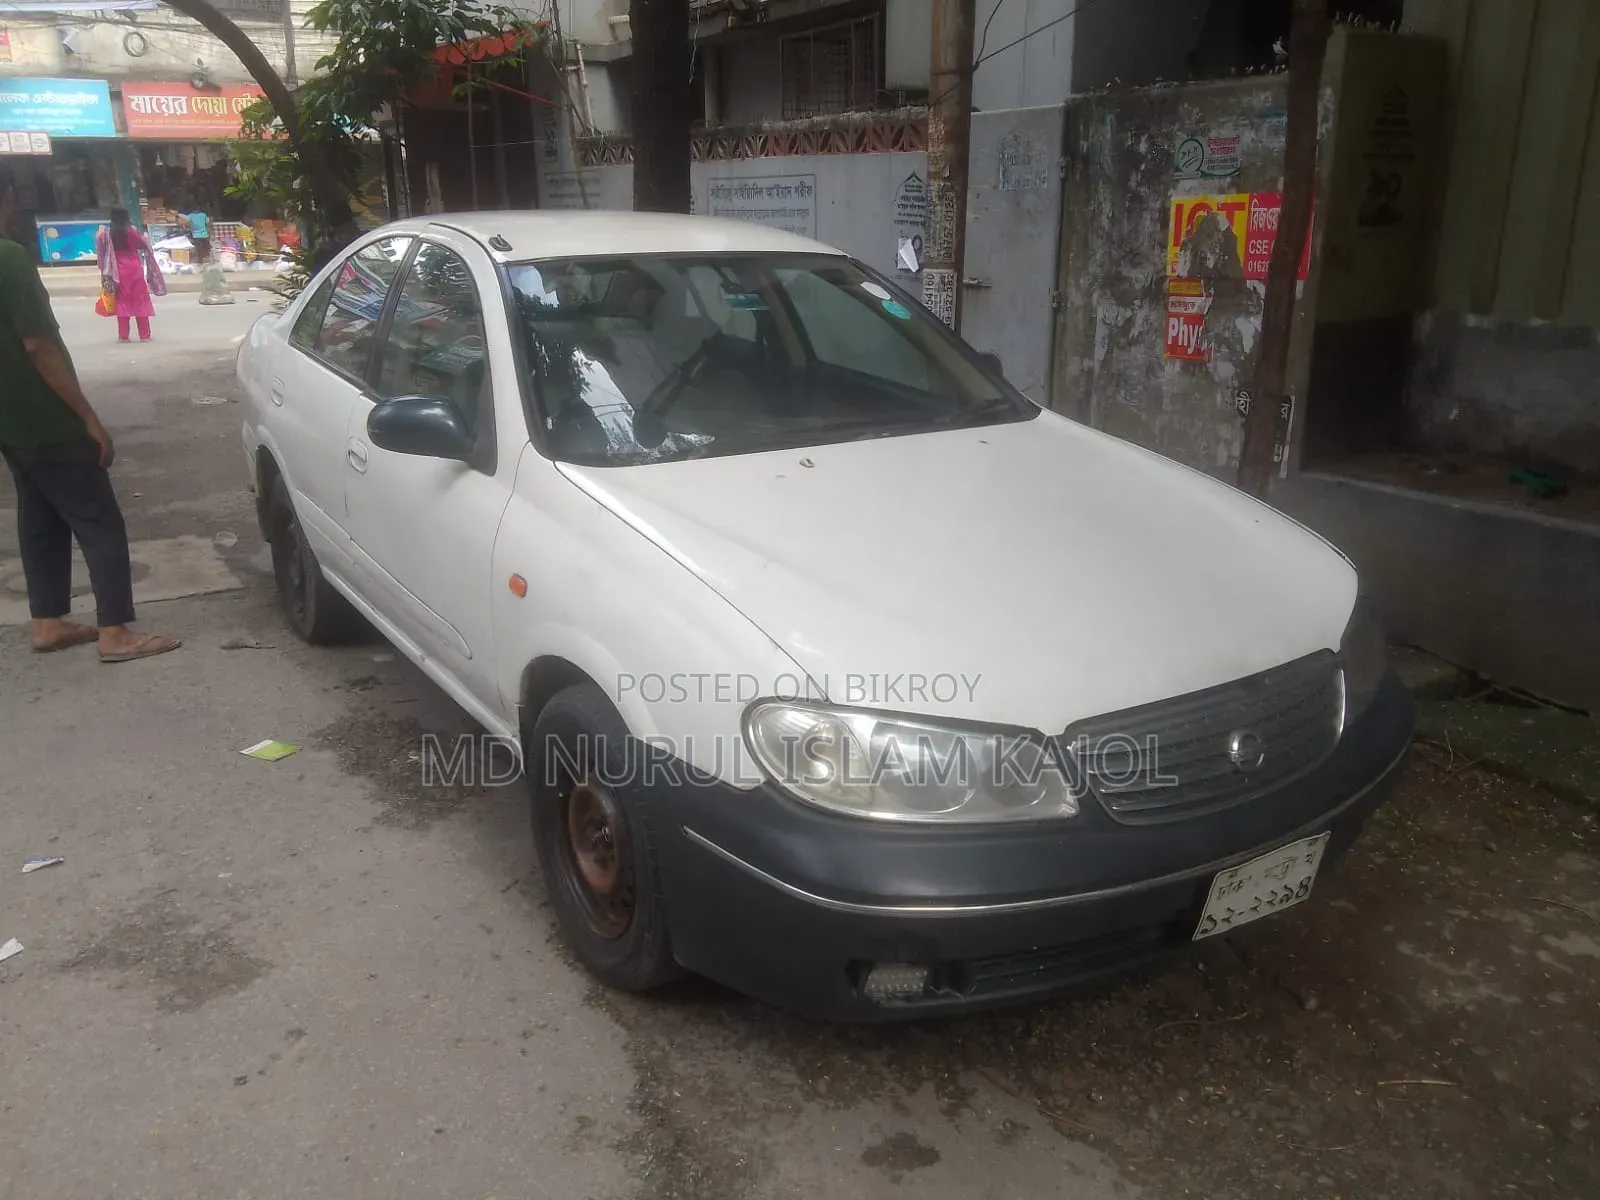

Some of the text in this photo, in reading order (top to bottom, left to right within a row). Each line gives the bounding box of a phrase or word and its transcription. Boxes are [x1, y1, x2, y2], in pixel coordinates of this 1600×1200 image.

[128, 95, 188, 116] মায়ের
[191, 96, 229, 116] দোয়া
[1249, 239, 1269, 255] CSE
